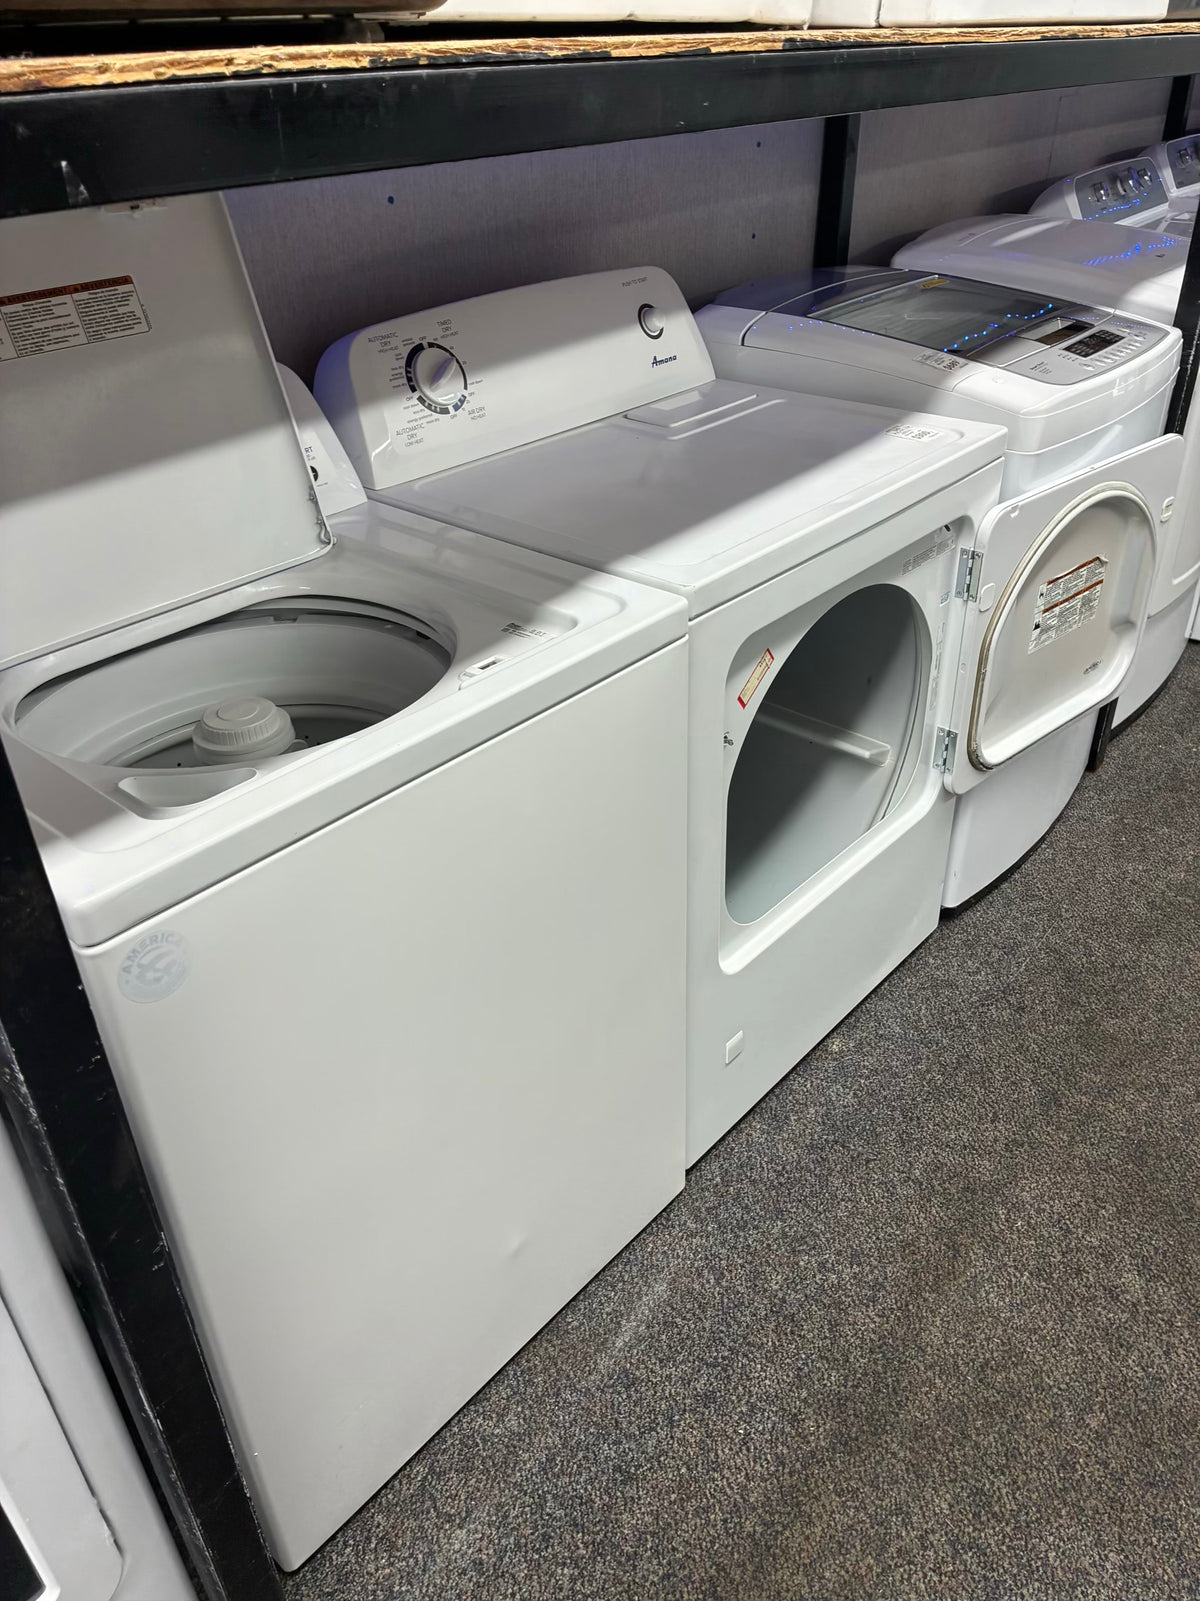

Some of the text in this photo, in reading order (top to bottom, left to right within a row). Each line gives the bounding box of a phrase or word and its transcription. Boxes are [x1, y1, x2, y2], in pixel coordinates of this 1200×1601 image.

[368, 331, 399, 343] AUTOMATIC
[380, 340, 392, 348] DRY
[651, 355, 678, 368] Amana
[475, 406, 486, 414] DRY
[396, 423, 425, 436] AUTOMATIC
